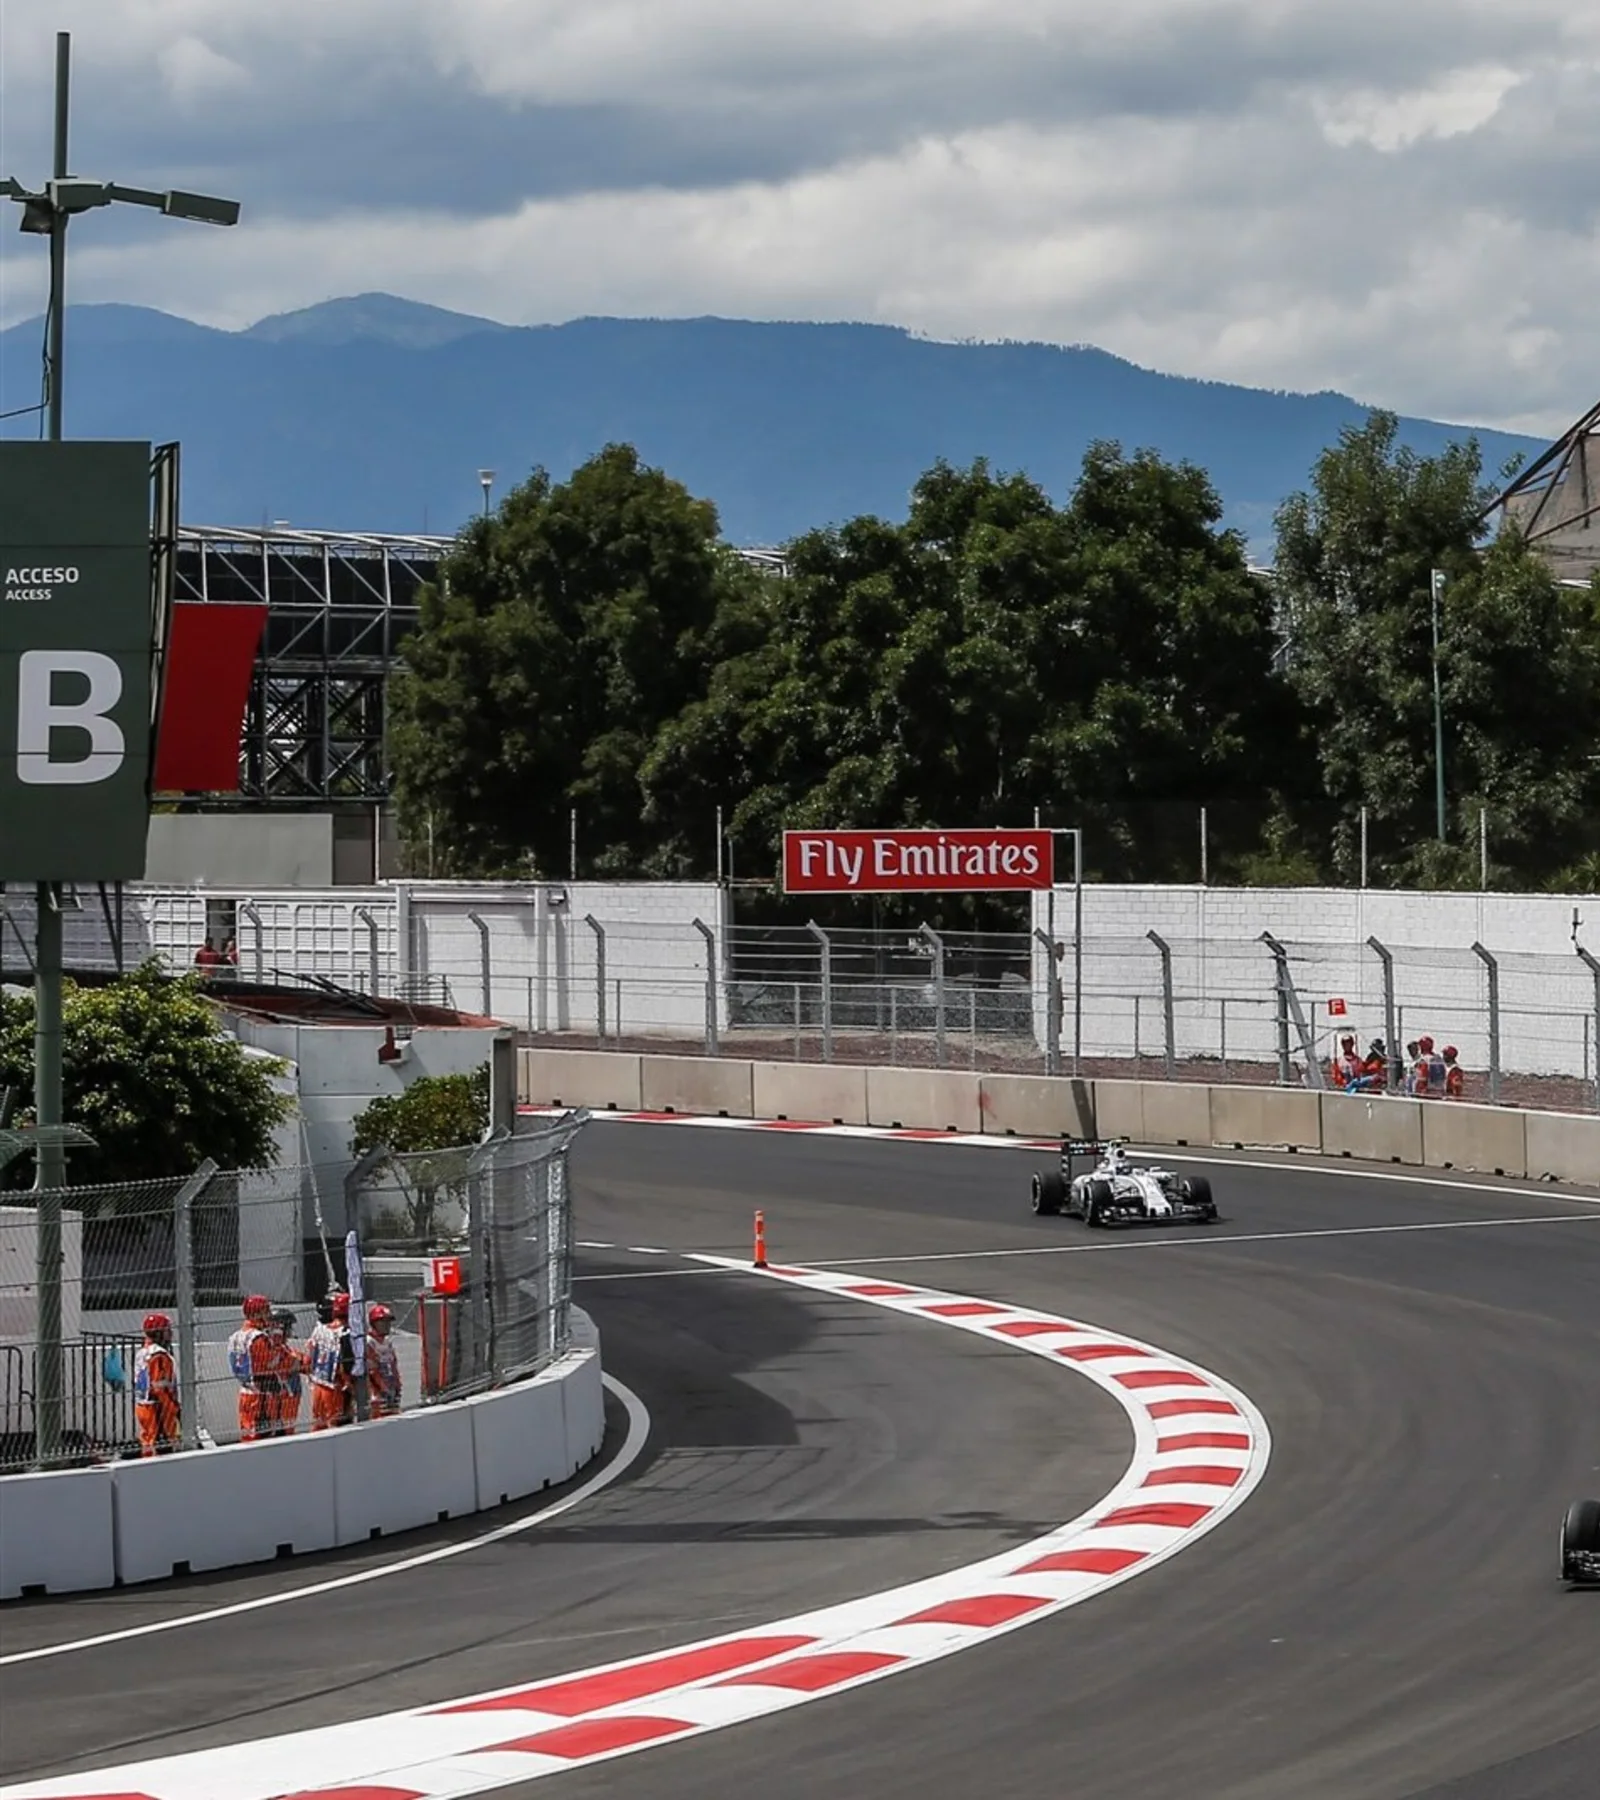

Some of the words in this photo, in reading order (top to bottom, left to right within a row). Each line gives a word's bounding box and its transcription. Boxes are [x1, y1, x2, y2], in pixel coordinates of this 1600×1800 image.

[6, 567, 79, 584] ACCESO
[6, 588, 52, 600] ACCESS
[17, 650, 125, 784] B
[799, 840, 864, 885] Fly
[872, 836, 1040, 876] Emirates
[438, 1262, 454, 1284] F
